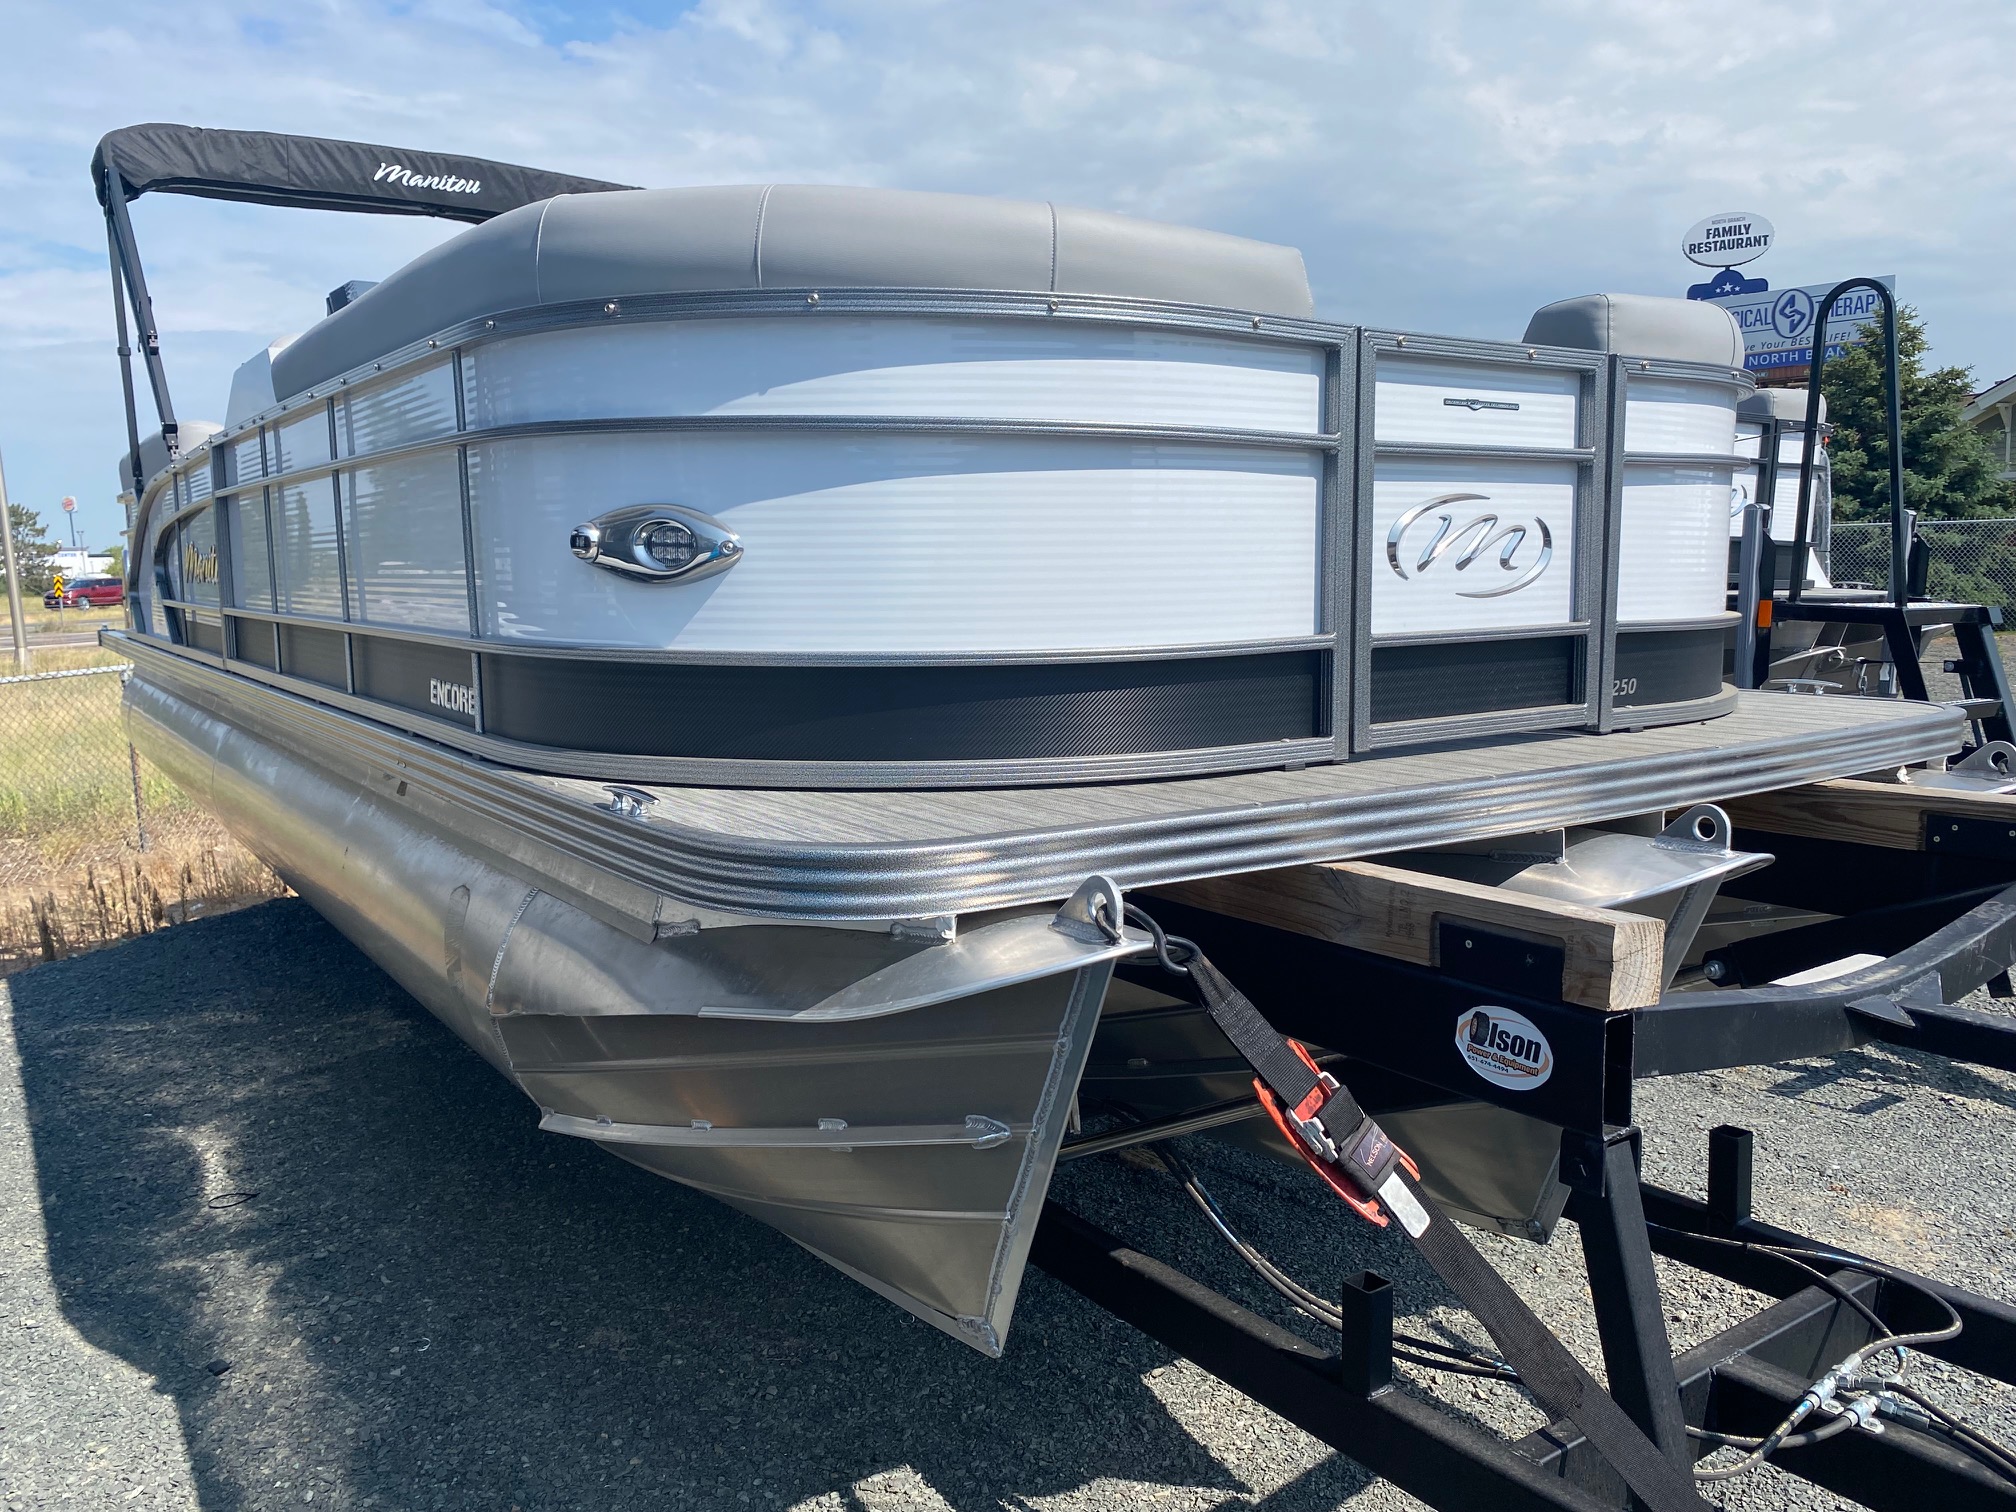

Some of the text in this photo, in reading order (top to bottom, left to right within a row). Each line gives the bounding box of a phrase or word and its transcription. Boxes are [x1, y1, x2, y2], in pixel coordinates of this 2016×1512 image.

[373, 162, 481, 194] Manitou
[1706, 223, 1752, 240] FAMILY
[1688, 234, 1769, 255] RESTAURANT
[1761, 340, 1786, 350] Your
[1791, 336, 1812, 347] BES
[1749, 351, 1799, 366] NORTH
[430, 677, 475, 716] ENCORE
[1612, 678, 1637, 696] 250
[1467, 1043, 1539, 1077] Power & Equipment
[1366, 1141, 1383, 1167] NELSON
